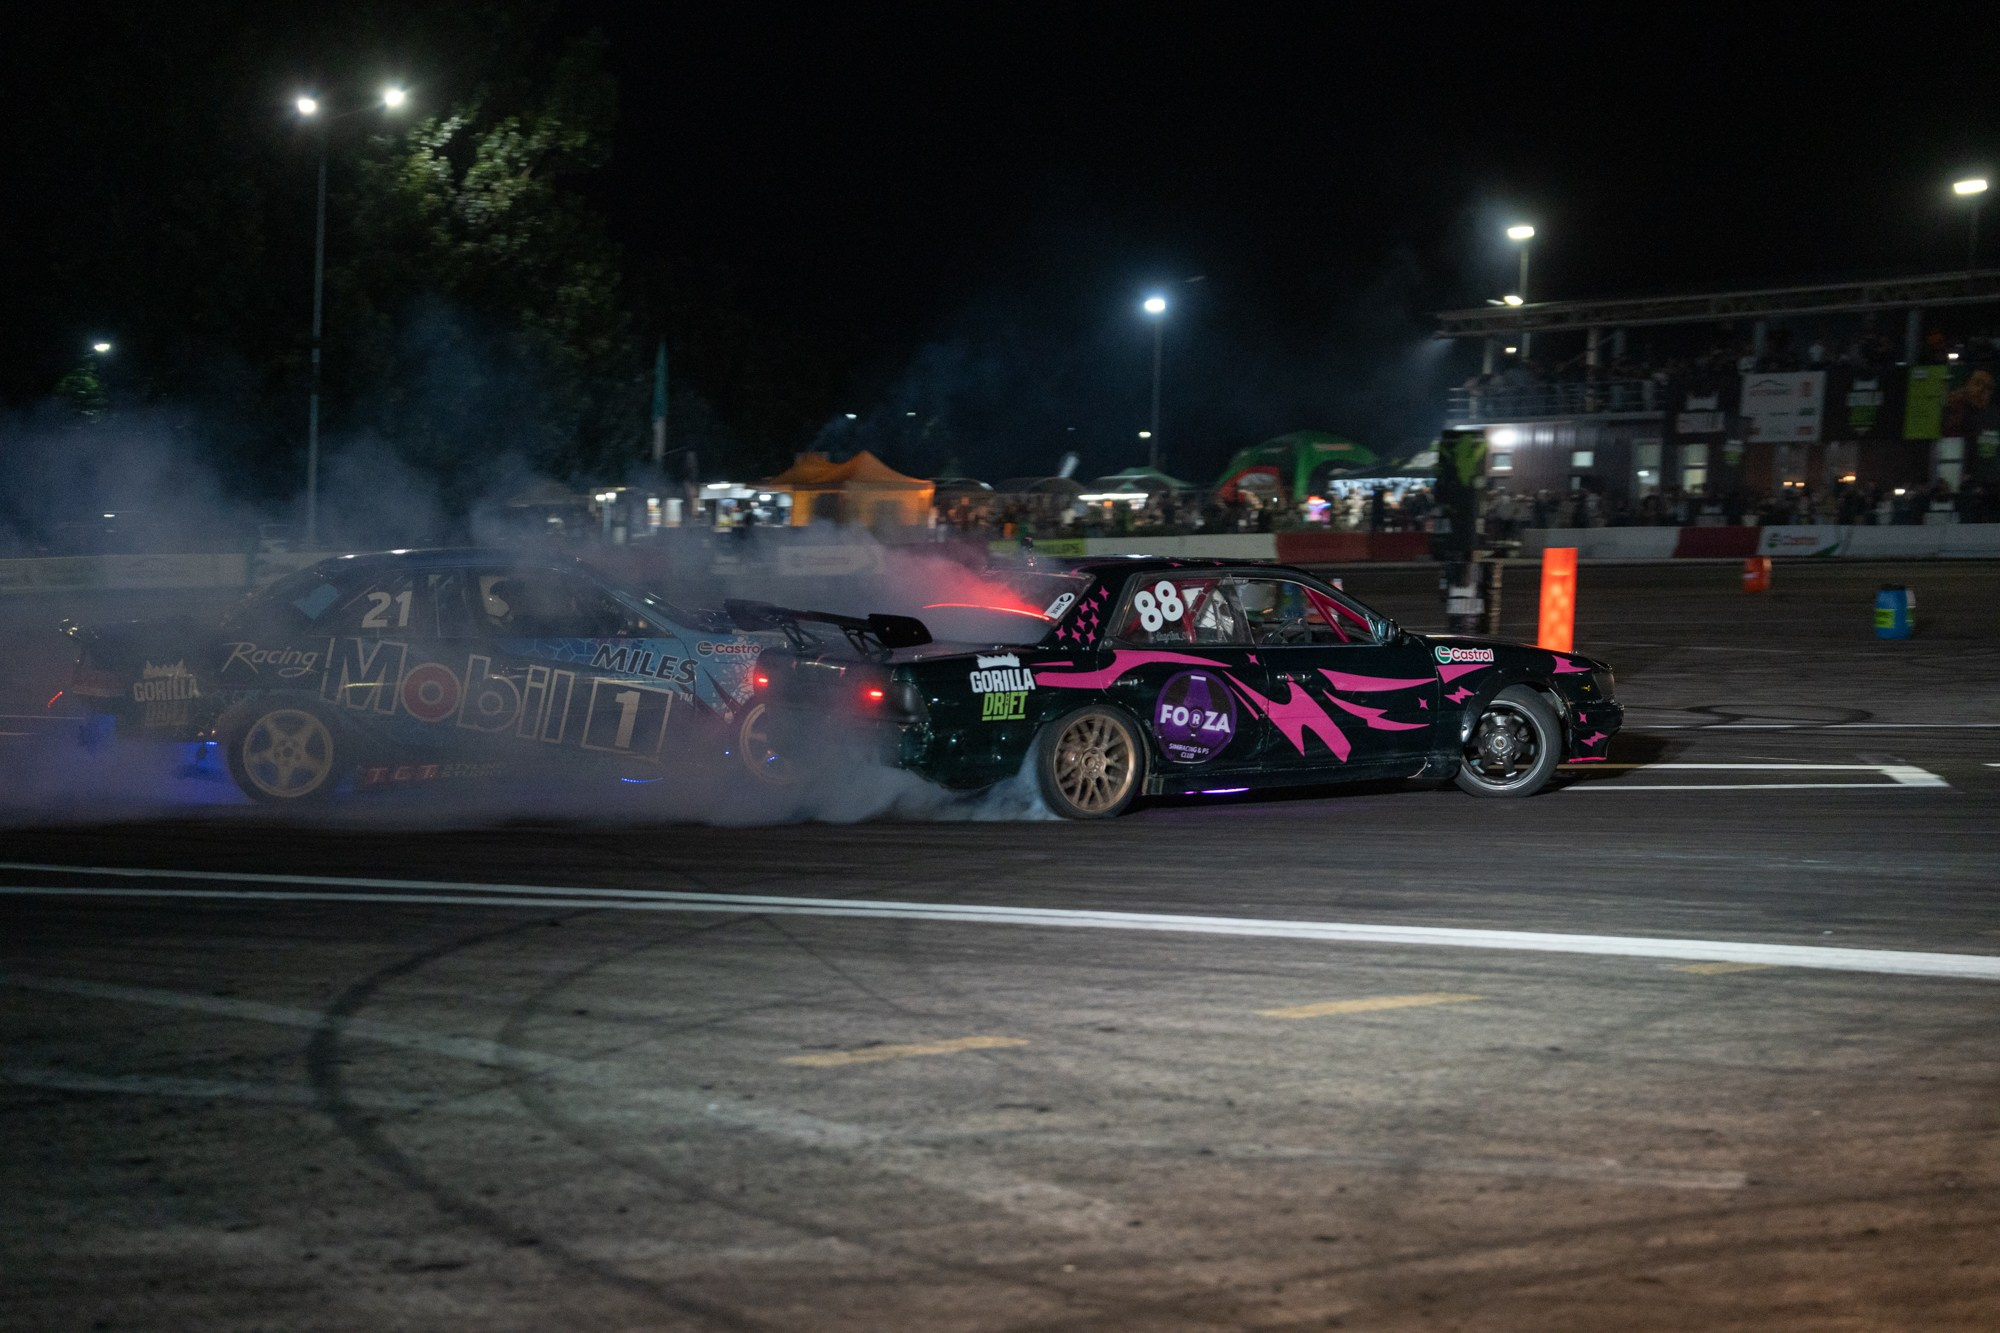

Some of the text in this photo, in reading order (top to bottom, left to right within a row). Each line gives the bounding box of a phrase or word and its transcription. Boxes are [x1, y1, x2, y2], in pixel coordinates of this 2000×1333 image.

[361, 591, 413, 628] 21
[1134, 580, 1184, 632] 88
[221, 641, 319, 678] Racing
[590, 644, 698, 685] MILES
[1451, 647, 1493, 661] Castrol
[133, 675, 201, 702] GORILLA
[320, 637, 575, 744] Mobil
[970, 668, 1036, 693] GORILLA
[982, 691, 1028, 721] DRIFT
[1160, 704, 1231, 733] FORZA
